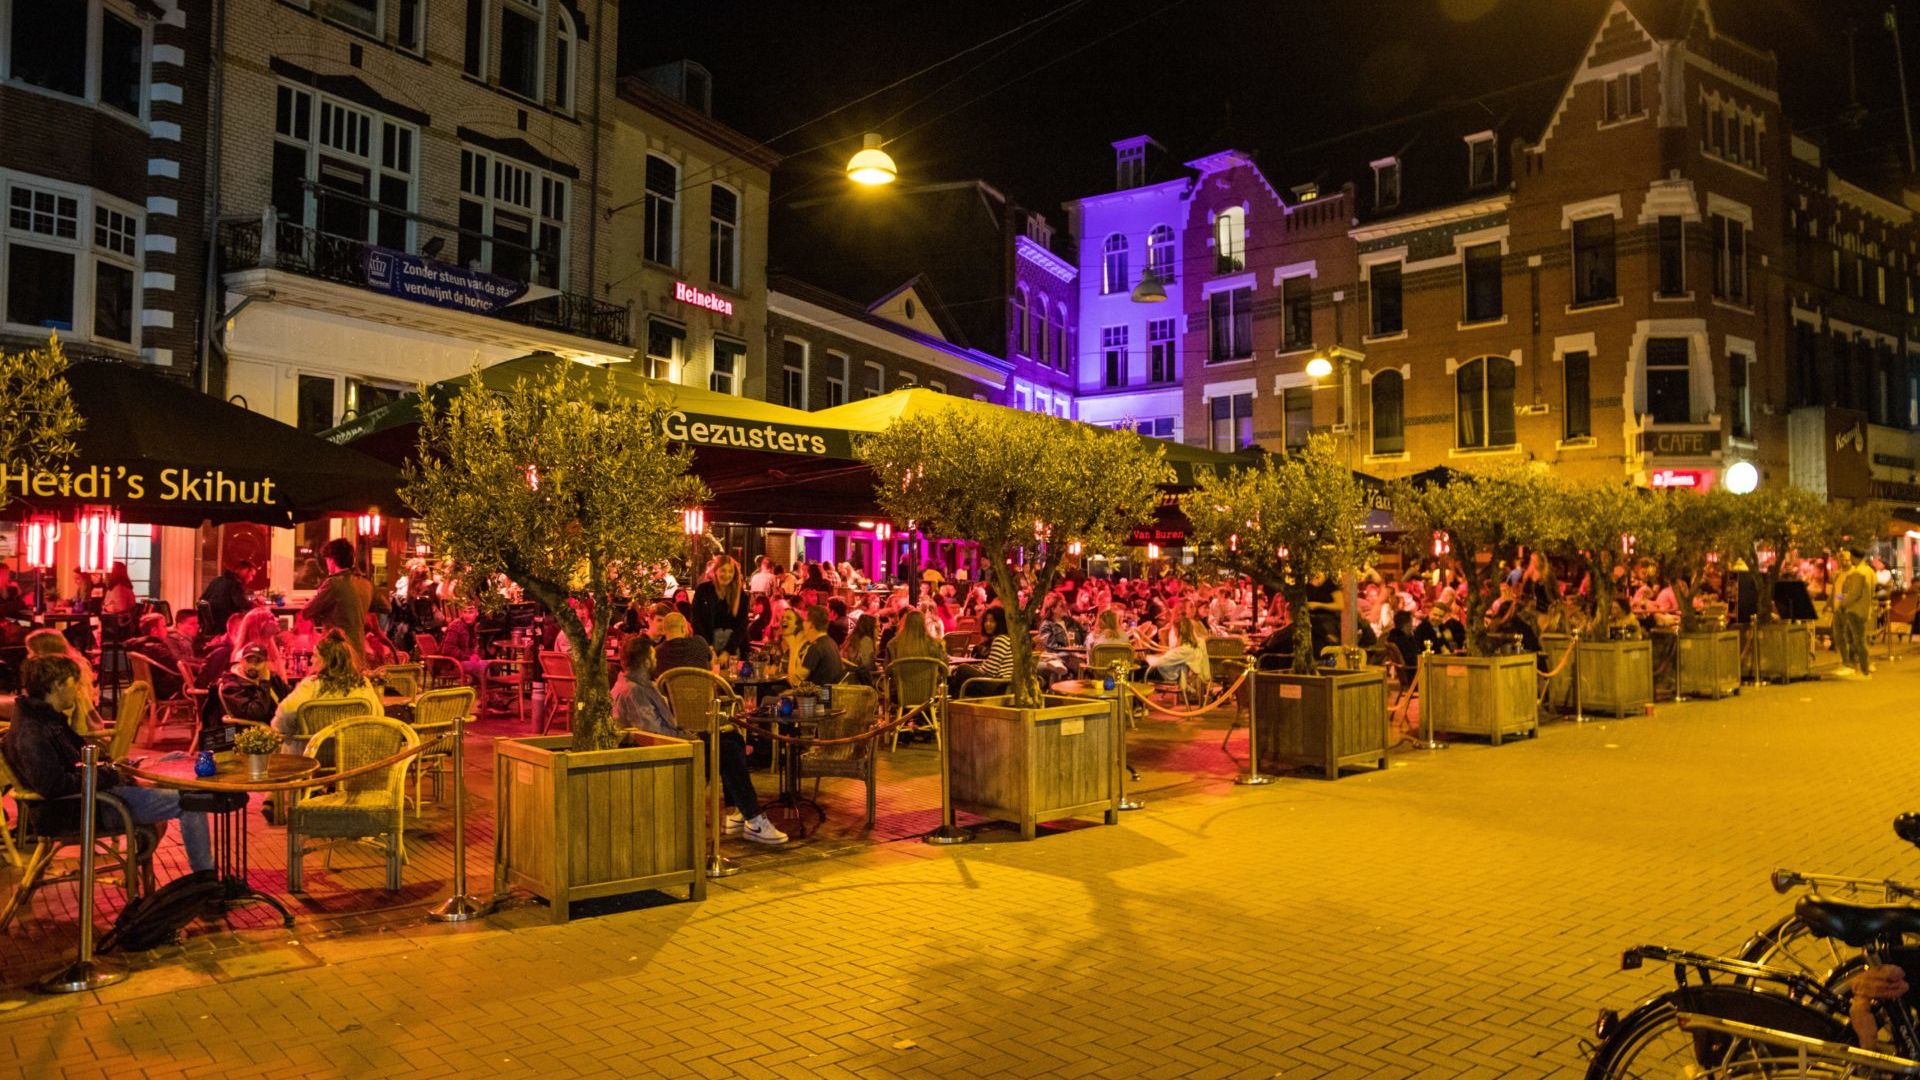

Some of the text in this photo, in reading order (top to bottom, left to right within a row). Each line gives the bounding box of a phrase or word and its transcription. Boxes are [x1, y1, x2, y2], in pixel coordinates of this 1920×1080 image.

[402, 261, 438, 281] Zonder
[439, 271, 467, 288] steun
[485, 281, 495, 294] de
[404, 282, 453, 302] verdwijnt
[453, 291, 464, 304] de
[675, 281, 734, 316] Heineken
[660, 410, 826, 454] Gezusters
[0, 463, 276, 504] Heidi's Skihut
[1367, 488, 1392, 510] Van
[1133, 529, 1185, 539] Van Buren
